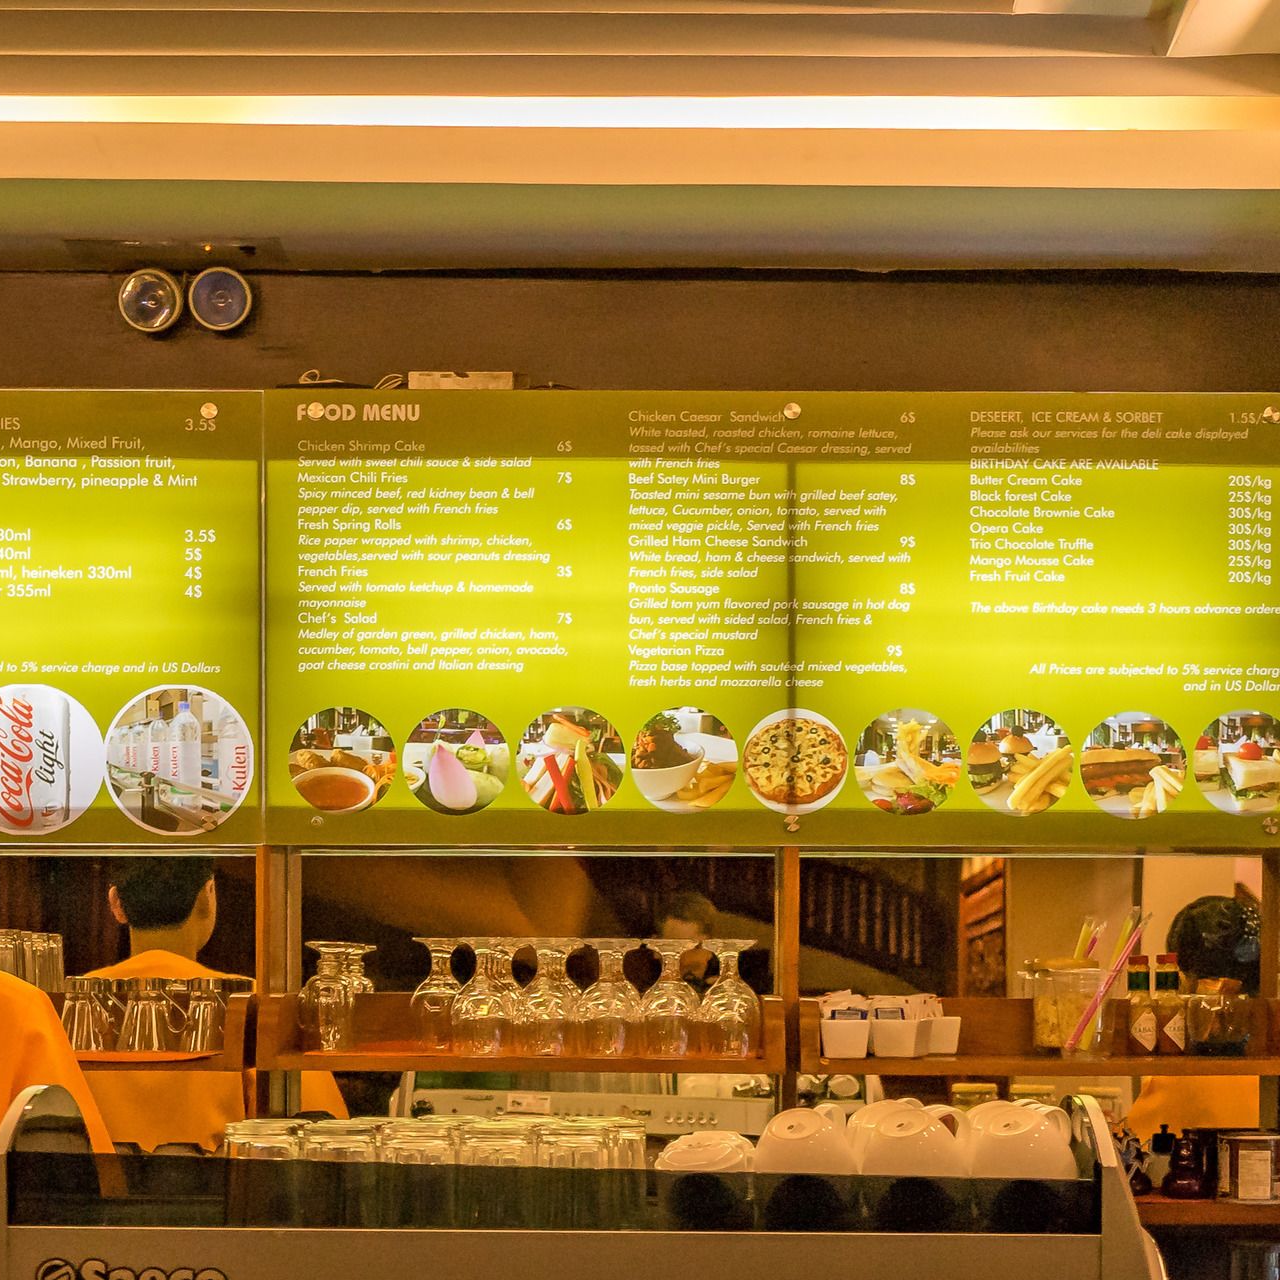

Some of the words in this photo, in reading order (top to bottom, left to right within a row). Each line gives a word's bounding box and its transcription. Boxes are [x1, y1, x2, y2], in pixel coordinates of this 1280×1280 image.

[296, 402, 356, 421] FOD
[363, 404, 420, 422] MENU
[628, 410, 676, 422] Chicken
[680, 410, 722, 422] Caesar
[730, 410, 785, 423] Sandwich
[900, 411, 916, 424] 6$
[1032, 411, 1052, 422] ICE
[1056, 411, 1099, 423] CREAM
[1102, 412, 1112, 423] &
[1116, 412, 1163, 423] SORBET
[185, 418, 216, 431] 3.5$
[297, 440, 345, 452] Chicken
[349, 440, 391, 454] Shrimp
[394, 440, 426, 452] Cake
[557, 440, 573, 452] 6$
[970, 458, 1030, 469] BIRTHDAY
[1033, 458, 1066, 470] CAKE
[1070, 458, 1093, 470] ARE
[1096, 459, 1159, 470] AVAILABLE
[297, 472, 346, 483] Mexican
[350, 471, 377, 483] Chili
[381, 471, 408, 484] Fries
[558, 472, 572, 484] 7$
[628, 472, 655, 484] Beef
[657, 473, 689, 487] Satey
[692, 473, 717, 484] Mini
[721, 473, 760, 487] Burger
[900, 474, 916, 486] 8$
[970, 474, 1003, 486] Butter
[1007, 473, 1047, 486] Cream
[1051, 474, 1082, 486] Cake
[1228, 475, 1272, 490] 20$/kg
[970, 489, 1001, 502] Black
[1004, 489, 1037, 502] forest
[1040, 490, 1072, 502] Cake
[1228, 491, 1272, 505] 25$/kg
[970, 505, 1030, 518] Chocolate
[1033, 506, 1080, 518] Brownie
[1084, 506, 1115, 518] Cake
[1228, 507, 1272, 521] 30$/kg
[298, 518, 329, 530] Fresh
[332, 518, 371, 533] Spring
[374, 518, 402, 530] Rolls
[556, 518, 572, 531] 6$
[969, 522, 1008, 536] Opera
[1012, 522, 1044, 534] Cake
[1228, 523, 1271, 538] 30$/kg
[184, 529, 216, 543] 3.5$
[628, 535, 669, 548] Grilled
[672, 535, 702, 547] Ham
[704, 535, 748, 547] Cheese
[752, 535, 808, 548] Sandwich
[900, 535, 916, 548] 9$
[969, 537, 991, 550] Trio
[994, 537, 1055, 550] Chocolate
[1057, 538, 1094, 550] Truffle
[1228, 539, 1271, 554] 30$/kg
[184, 547, 202, 562] 5$
[970, 554, 1012, 569] Mango
[1015, 554, 1059, 566] Mousse
[1063, 554, 1094, 566] Cake
[1228, 555, 1271, 570] 25$/kg
[21, 565, 83, 579] heineken
[88, 565, 132, 579] 330ml
[184, 566, 202, 580] 4$
[298, 565, 337, 577] French
[340, 564, 368, 578] Fries
[556, 565, 572, 578] 3$
[969, 569, 1001, 582] Fresh
[1004, 570, 1030, 582] Fruit
[1033, 569, 1065, 582] Cake
[1228, 570, 1271, 586] 20$/kg
[6, 583, 51, 598] 355ml
[184, 584, 202, 599] 4$
[628, 582, 668, 595] Pronto
[670, 582, 719, 597] Sausage
[899, 582, 916, 595] 8$
[344, 610, 378, 624] Salad
[557, 612, 573, 625] 7$
[627, 643, 691, 660] Vegetarian
[695, 643, 724, 656] Pizza
[886, 645, 903, 657] 9$
[35, 729, 65, 785] light
[230, 745, 248, 791] Kulen
